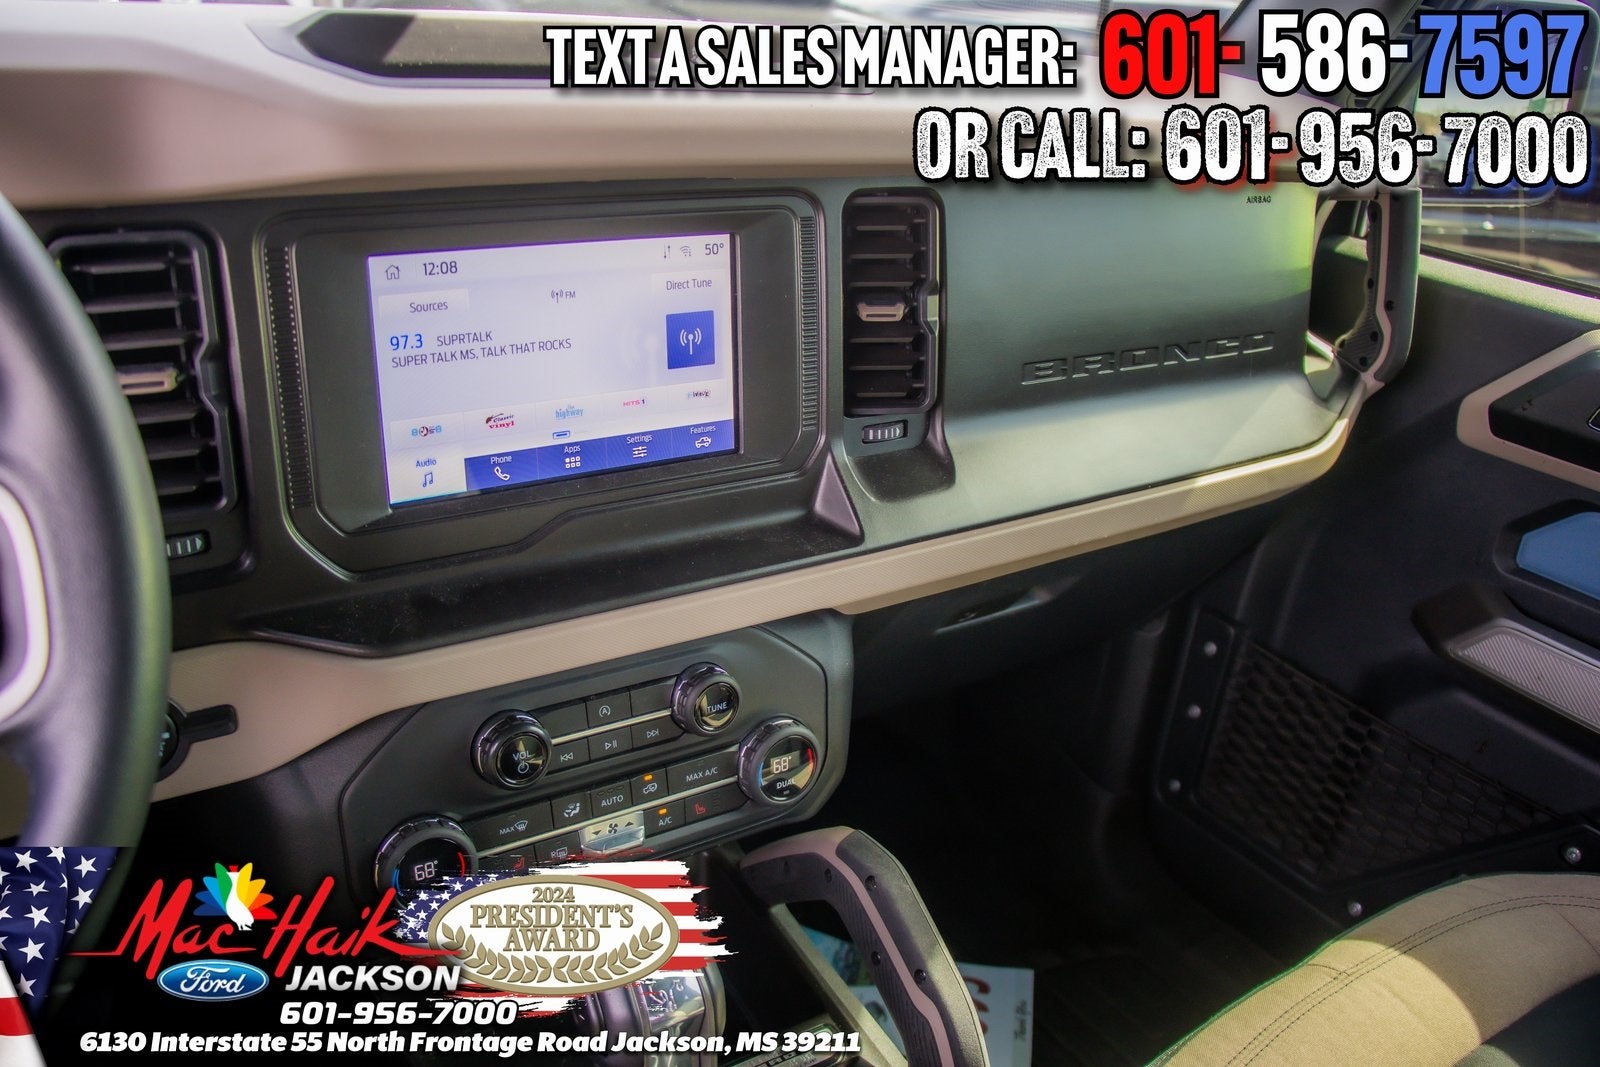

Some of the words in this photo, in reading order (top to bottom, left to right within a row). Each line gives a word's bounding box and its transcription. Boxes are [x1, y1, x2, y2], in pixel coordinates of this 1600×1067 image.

[1246, 195, 1272, 204] AIRBAG
[704, 242, 725, 256] 50°
[422, 260, 458, 277] 12:08
[665, 279, 690, 291] Direct
[692, 278, 713, 289] Tune
[564, 290, 577, 300] FM
[409, 300, 449, 313] Sources
[389, 333, 424, 351] 97.3
[436, 330, 493, 347] SUPRTALK
[391, 353, 428, 369] SUPER
[430, 350, 458, 364] TALK
[481, 345, 508, 359] TALK
[509, 341, 537, 354] THAT
[538, 338, 572, 352] ROCKS
[1021, 331, 1275, 386] BRONCO
[554, 406, 584, 420] highway
[488, 420, 516, 430] vinyl
[689, 424, 717, 435] Features
[625, 433, 653, 445] Settings
[563, 444, 582, 455] Apps
[415, 458, 437, 469] Audio
[490, 454, 513, 465] Phone
[706, 701, 728, 714] TUNE
[512, 750, 532, 761] VOL
[773, 755, 792, 774] 68°
[685, 771, 703, 783] MAX
[704, 766, 719, 777] A/C
[776, 777, 796, 790] DUAL
[600, 794, 624, 808] AUTO
[658, 815, 673, 827] A/C
[499, 825, 515, 836] MAX
[414, 860, 438, 882] 68°
